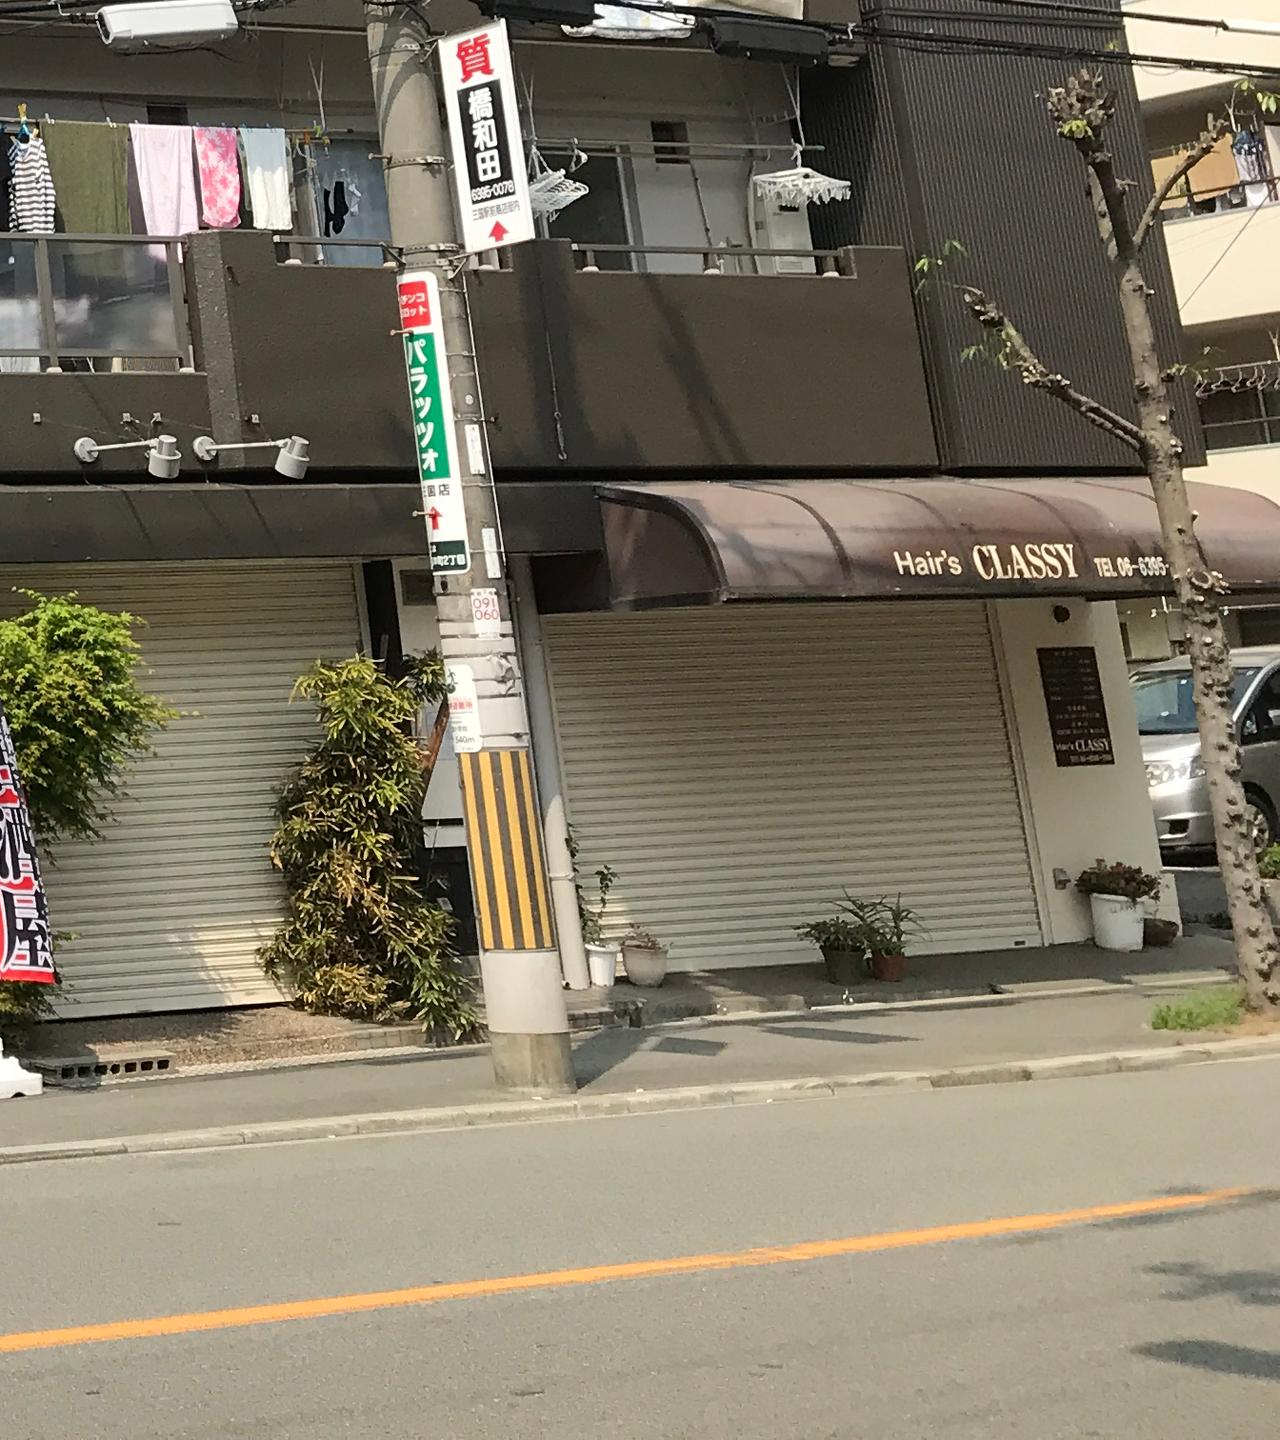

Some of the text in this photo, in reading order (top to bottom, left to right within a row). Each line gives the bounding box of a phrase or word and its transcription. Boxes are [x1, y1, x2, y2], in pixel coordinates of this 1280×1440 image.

[455, 33, 494, 84] 質
[468, 86, 502, 183] 橋和田
[423, 484, 450, 497] 国店
[894, 544, 1170, 581] Hair's CLASSY TEL 06-6395-
[473, 597, 496, 608] 091
[475, 609, 499, 620] 060
[1075, 738, 1111, 753] CLASSY
